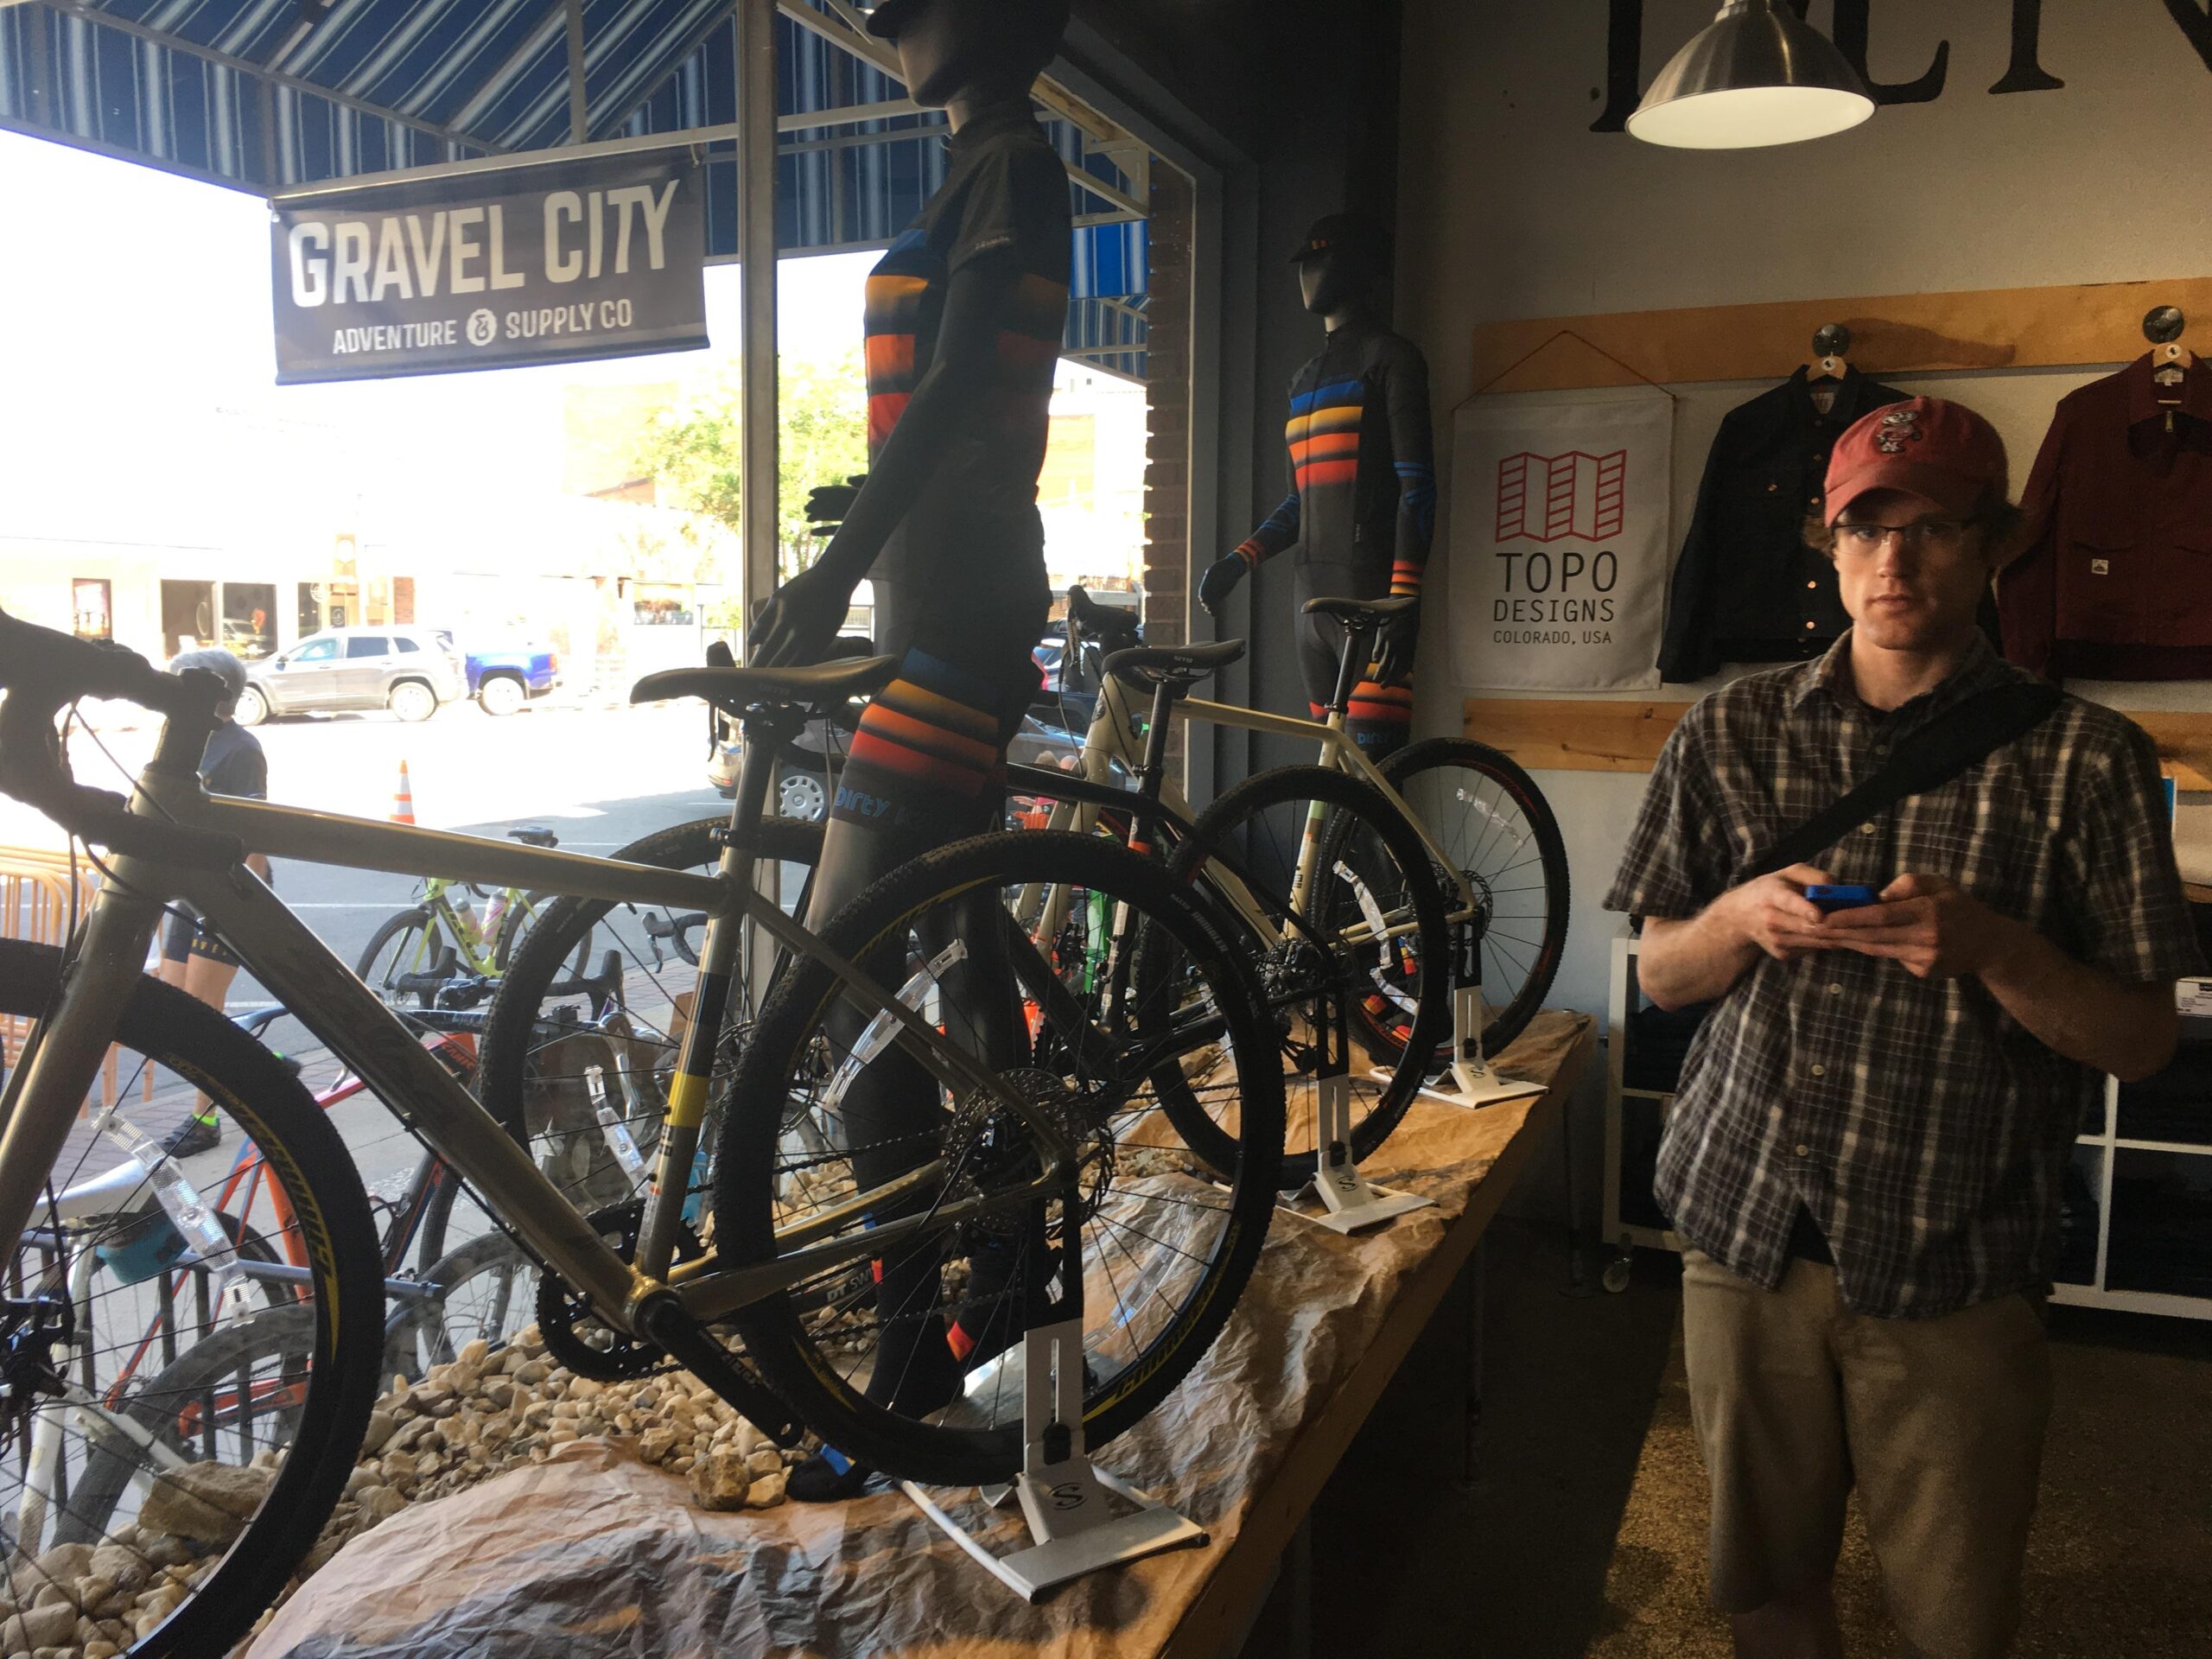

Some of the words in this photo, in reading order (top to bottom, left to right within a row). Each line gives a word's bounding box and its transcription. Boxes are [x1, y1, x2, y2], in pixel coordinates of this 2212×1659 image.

[289, 205, 525, 308] GRAVEL
[544, 179, 680, 283] CITY
[333, 320, 457, 354] ADVENTURE
[505, 302, 596, 339] SUPPLY
[600, 299, 632, 329] CO
[1496, 550, 1618, 594] TOPO
[1493, 599, 1615, 623] DESIGNS
[1493, 630, 1576, 645] COLORADO,
[1583, 630, 1613, 645] USA
